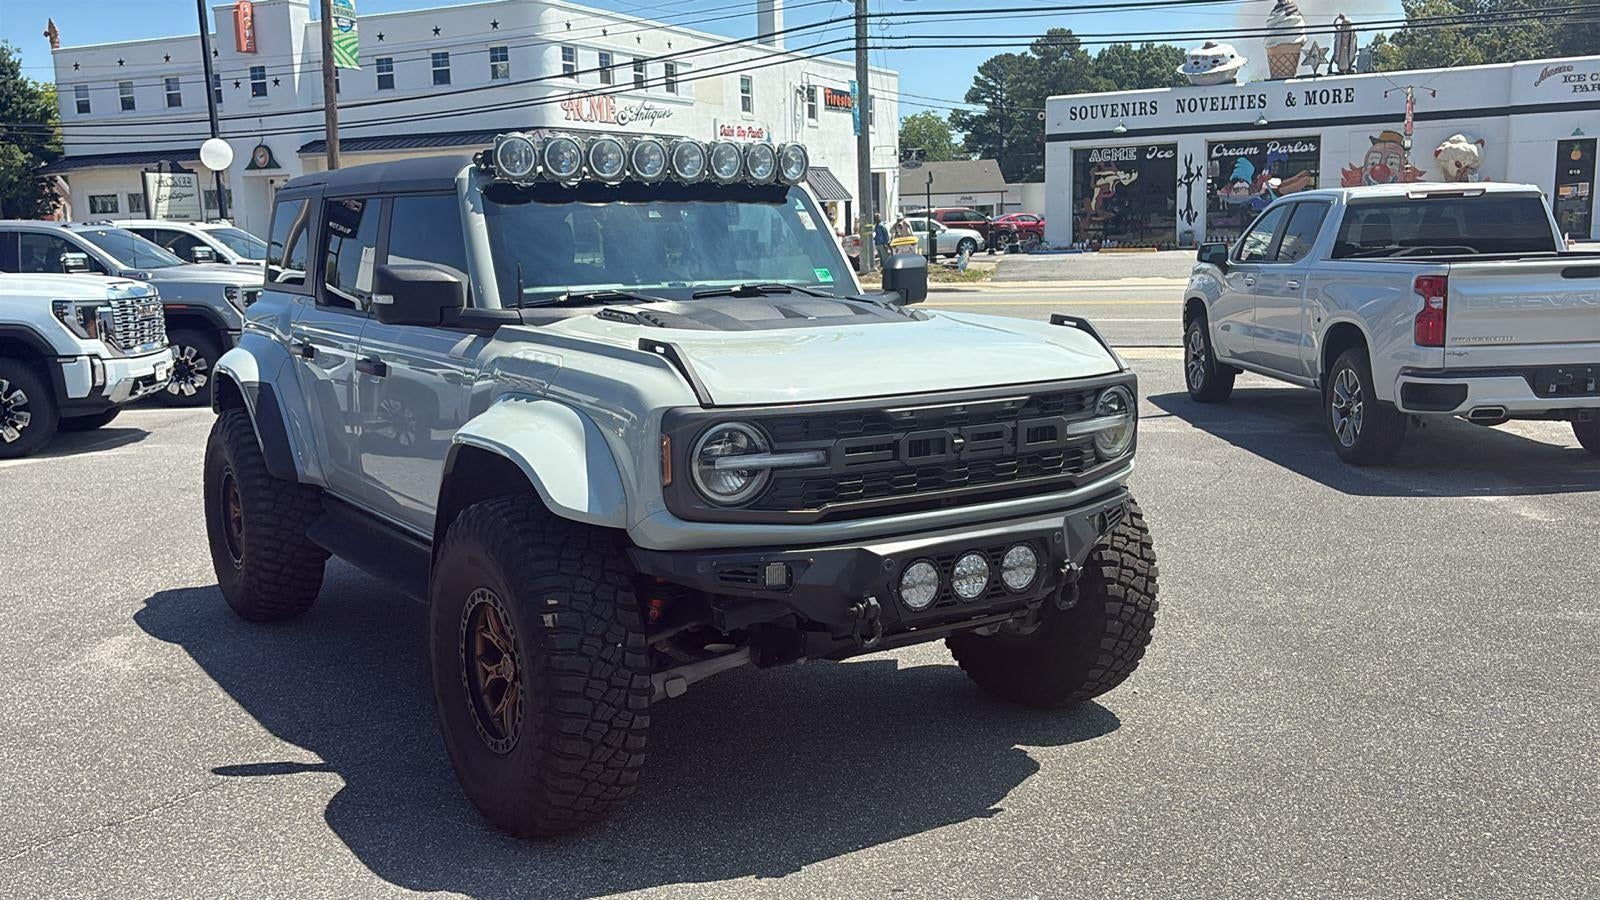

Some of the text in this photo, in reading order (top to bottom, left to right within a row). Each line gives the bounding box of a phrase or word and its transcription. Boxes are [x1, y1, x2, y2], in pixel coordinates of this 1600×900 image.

[1562, 74, 1586, 83] ICE
[825, 87, 853, 107] Firesto
[1070, 87, 1355, 121] SOUVENIRS NOVELTIES & MORE
[561, 91, 673, 127] ACME Antiques
[720, 124, 764, 141] Dutch Boy Paints
[1089, 145, 1175, 162] ACME Ice
[1211, 141, 1317, 158] Cream Parlor
[832, 416, 1067, 475] FORD
